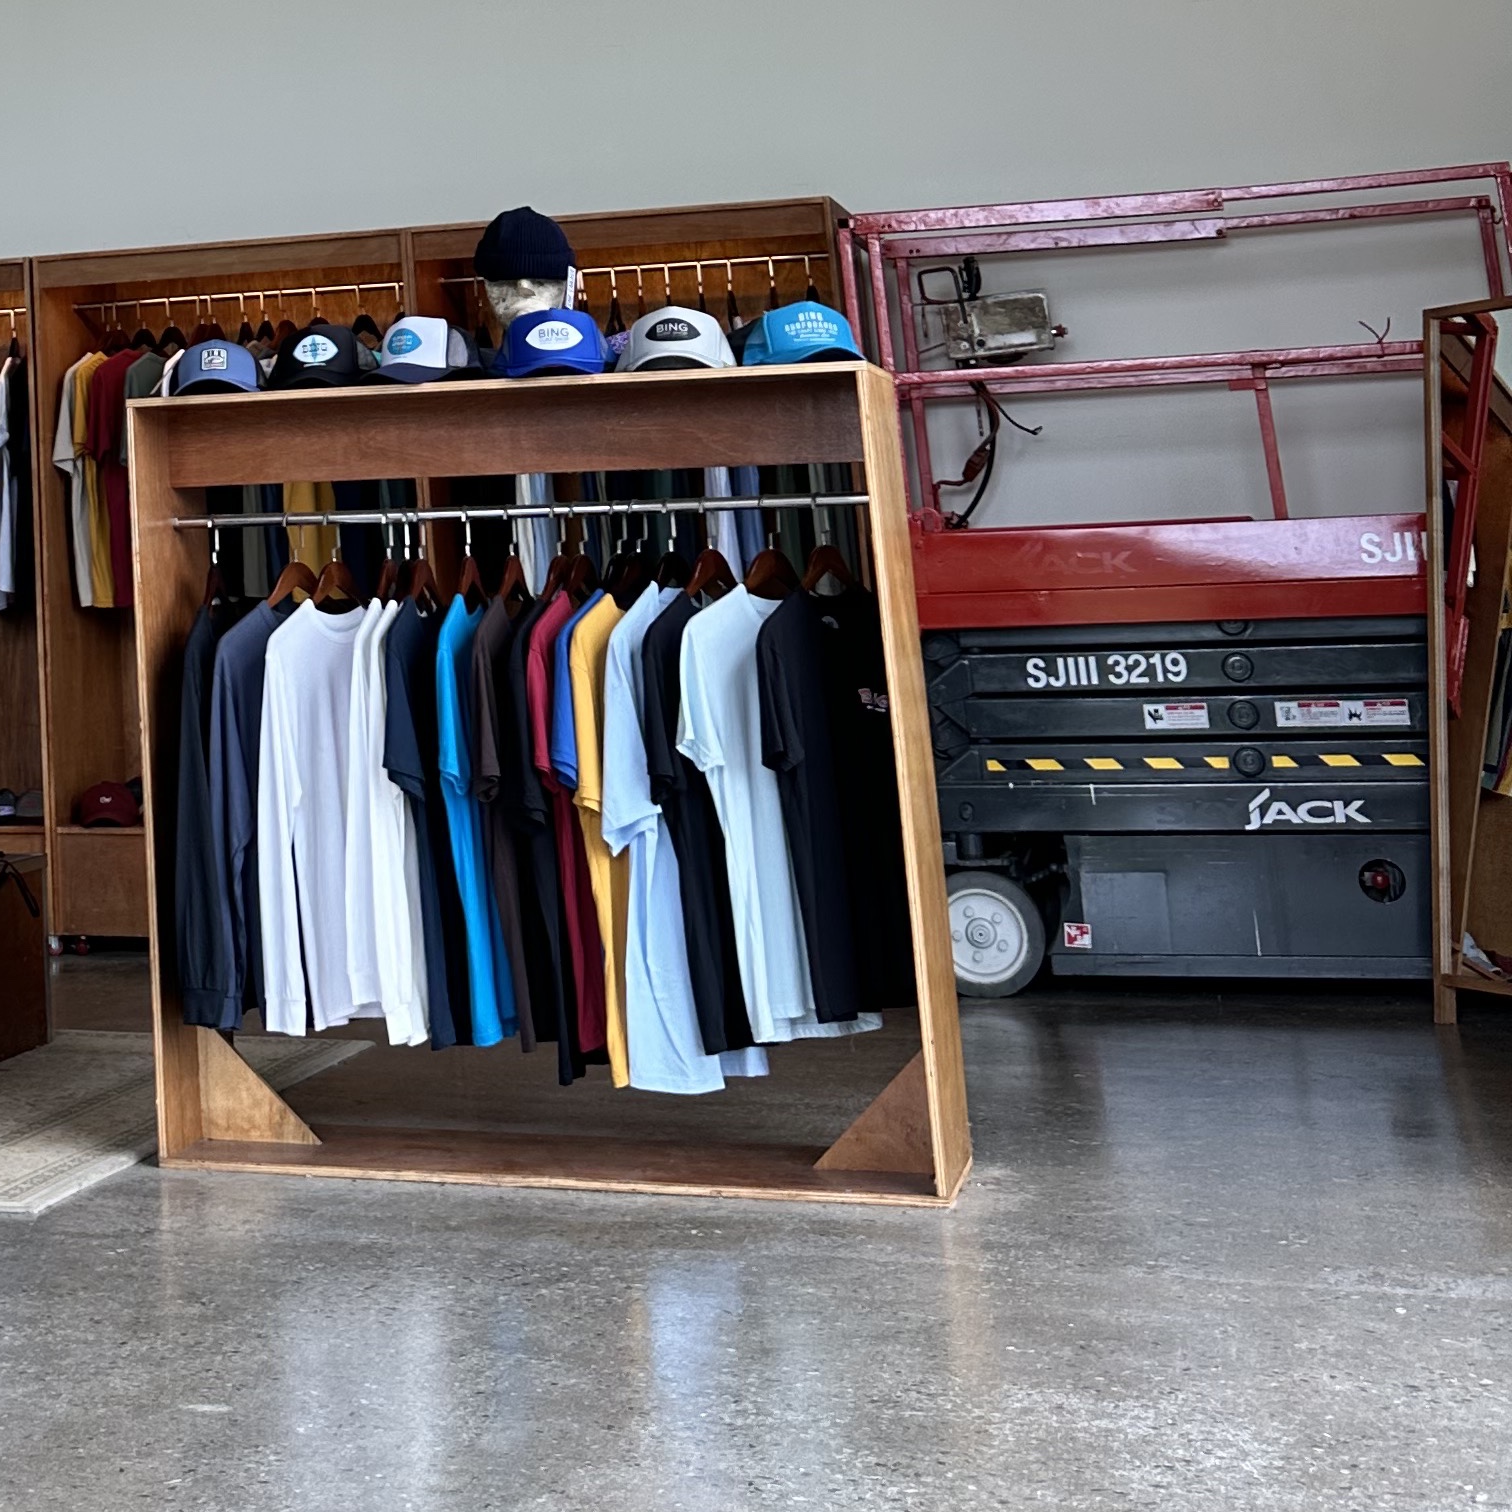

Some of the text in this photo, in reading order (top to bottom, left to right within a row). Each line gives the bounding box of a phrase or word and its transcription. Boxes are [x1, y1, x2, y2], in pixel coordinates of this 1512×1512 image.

[537, 327, 570, 340] BING
[656, 322, 689, 334] BING
[1025, 652, 1188, 689] SJIII 3219
